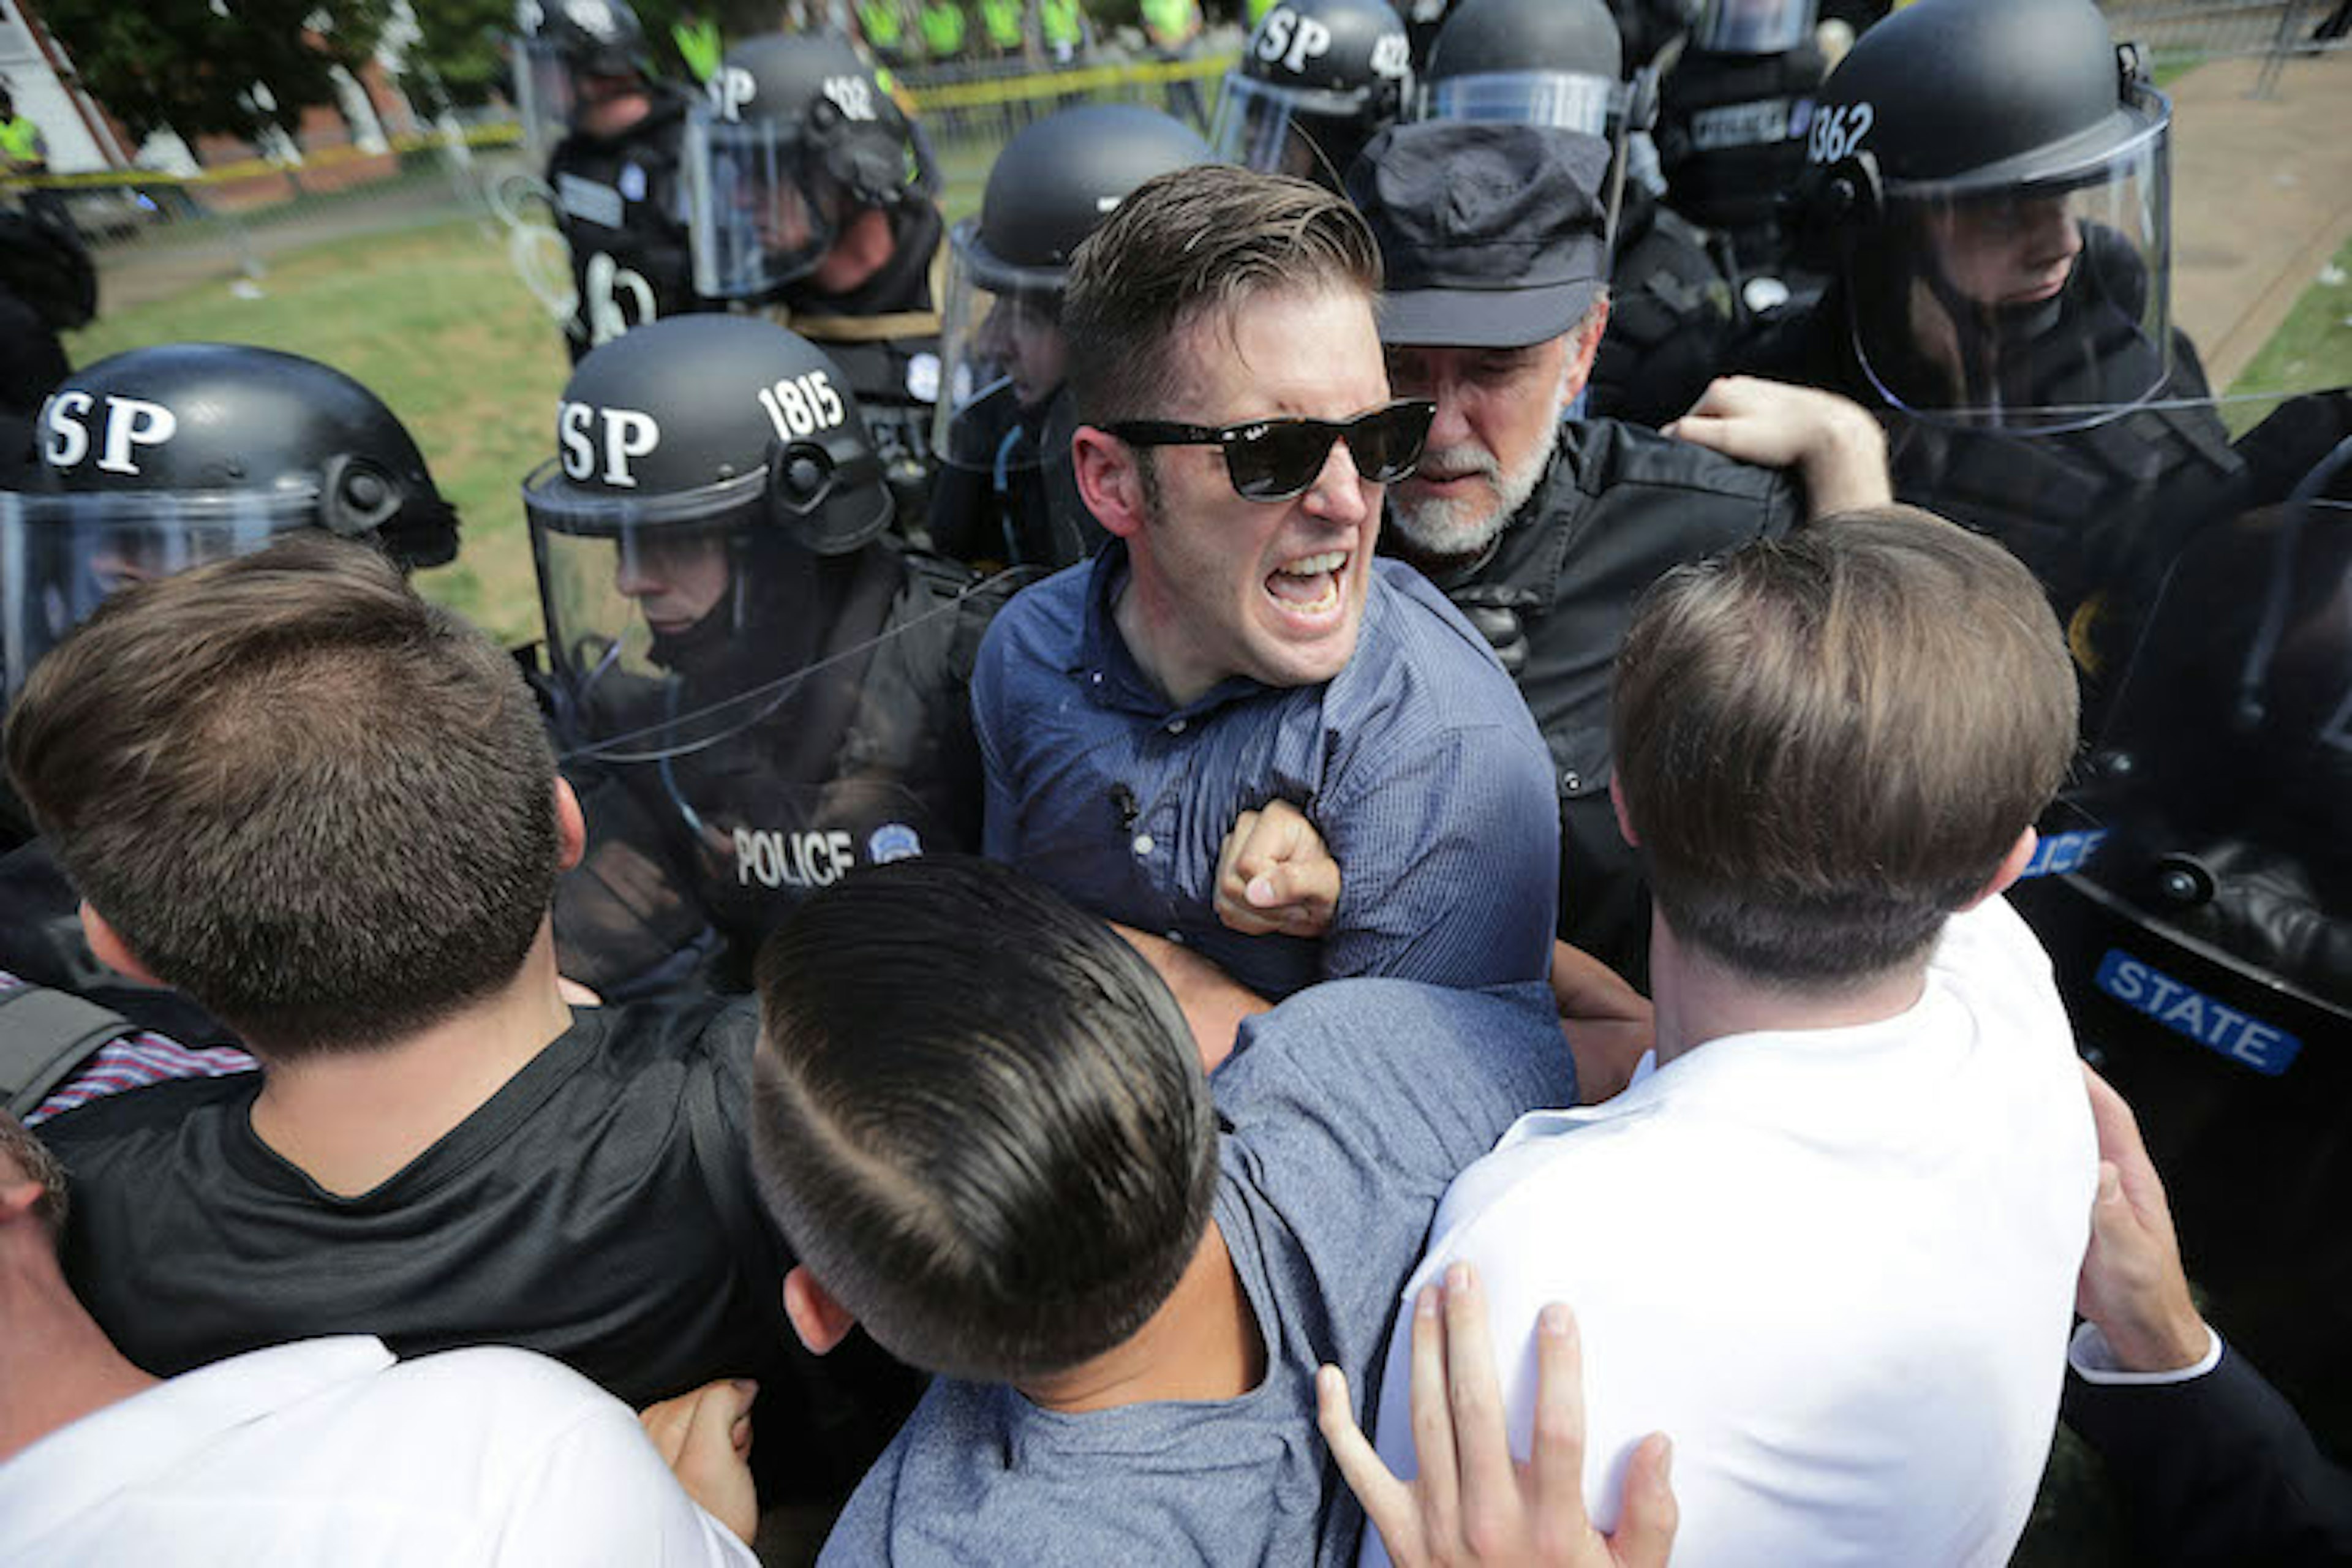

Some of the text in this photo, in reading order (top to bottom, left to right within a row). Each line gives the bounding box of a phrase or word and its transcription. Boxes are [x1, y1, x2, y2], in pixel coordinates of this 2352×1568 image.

[1257, 6, 1331, 74] SP
[758, 369, 844, 442] 1815
[559, 402, 660, 487] SP
[733, 827, 855, 886] POLICE
[2109, 960, 2282, 1066] STATE
